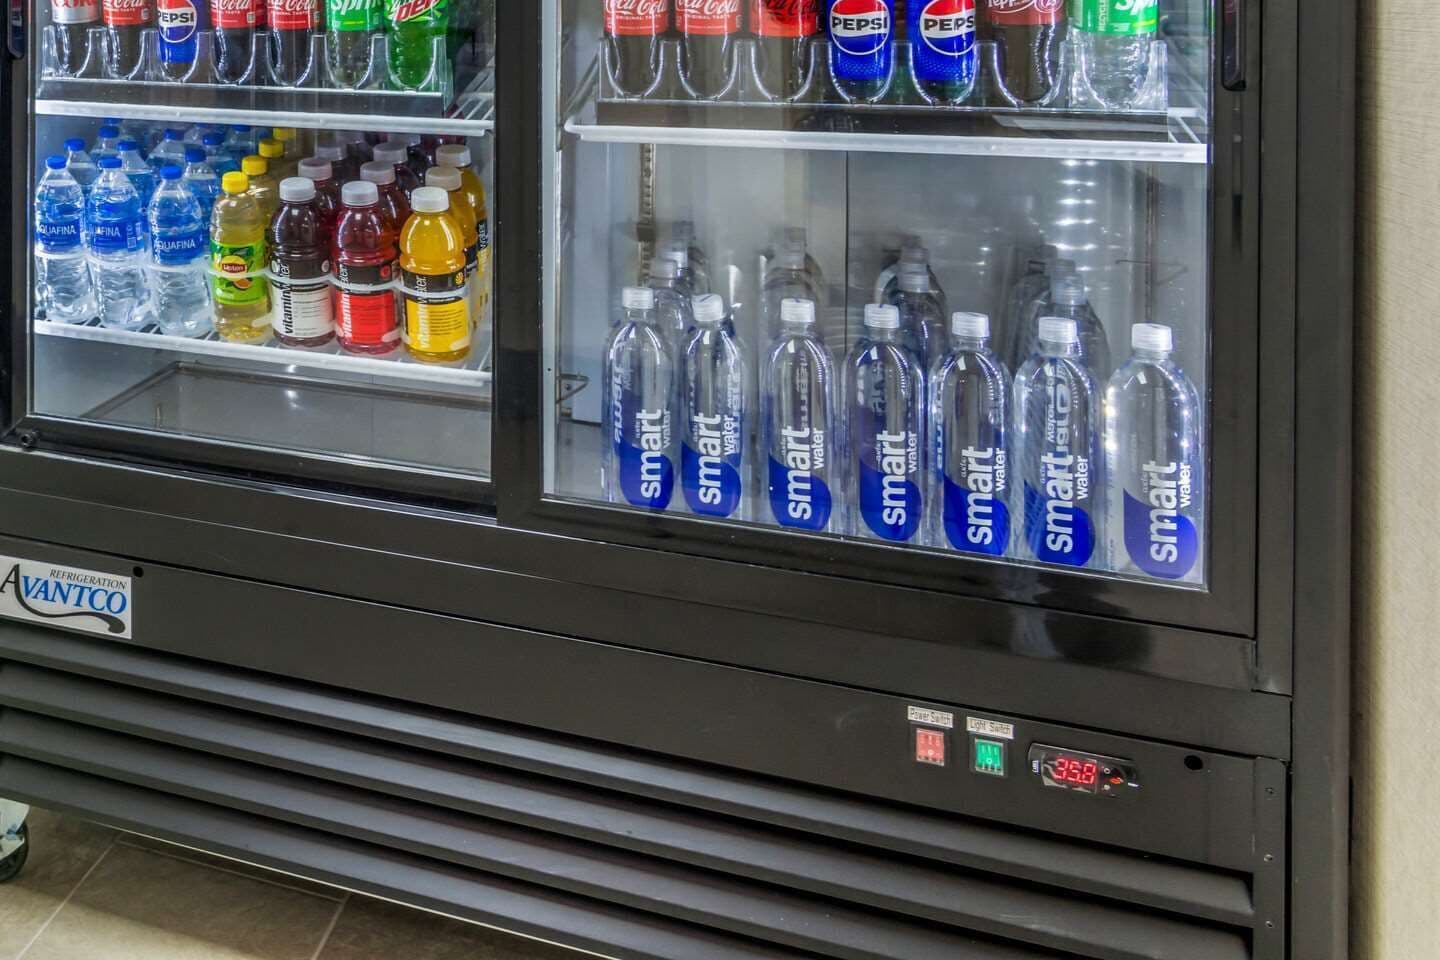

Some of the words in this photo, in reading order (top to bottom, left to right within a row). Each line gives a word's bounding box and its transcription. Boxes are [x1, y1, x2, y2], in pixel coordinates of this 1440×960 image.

[158, 11, 195, 24] PEPSI
[832, 16, 887, 31] PEPSI
[924, 14, 974, 31] PEPS
[635, 408, 662, 499] smart
[722, 415, 736, 455] water
[812, 428, 824, 470] water
[907, 430, 918, 473] water
[693, 412, 721, 505] smart
[781, 426, 812, 519] smart
[876, 430, 906, 525] smart
[994, 448, 1006, 491] water
[1075, 455, 1089, 499] water
[962, 446, 993, 545] smart
[1041, 452, 1073, 553] smart
[1177, 462, 1192, 507] water
[1142, 461, 1178, 563] smart
[49, 568, 127, 590] REFRIGERATION
[910, 708, 930, 720] Power
[930, 712, 951, 725] Switch
[970, 719, 987, 731] Light
[989, 722, 1011, 735] Switch
